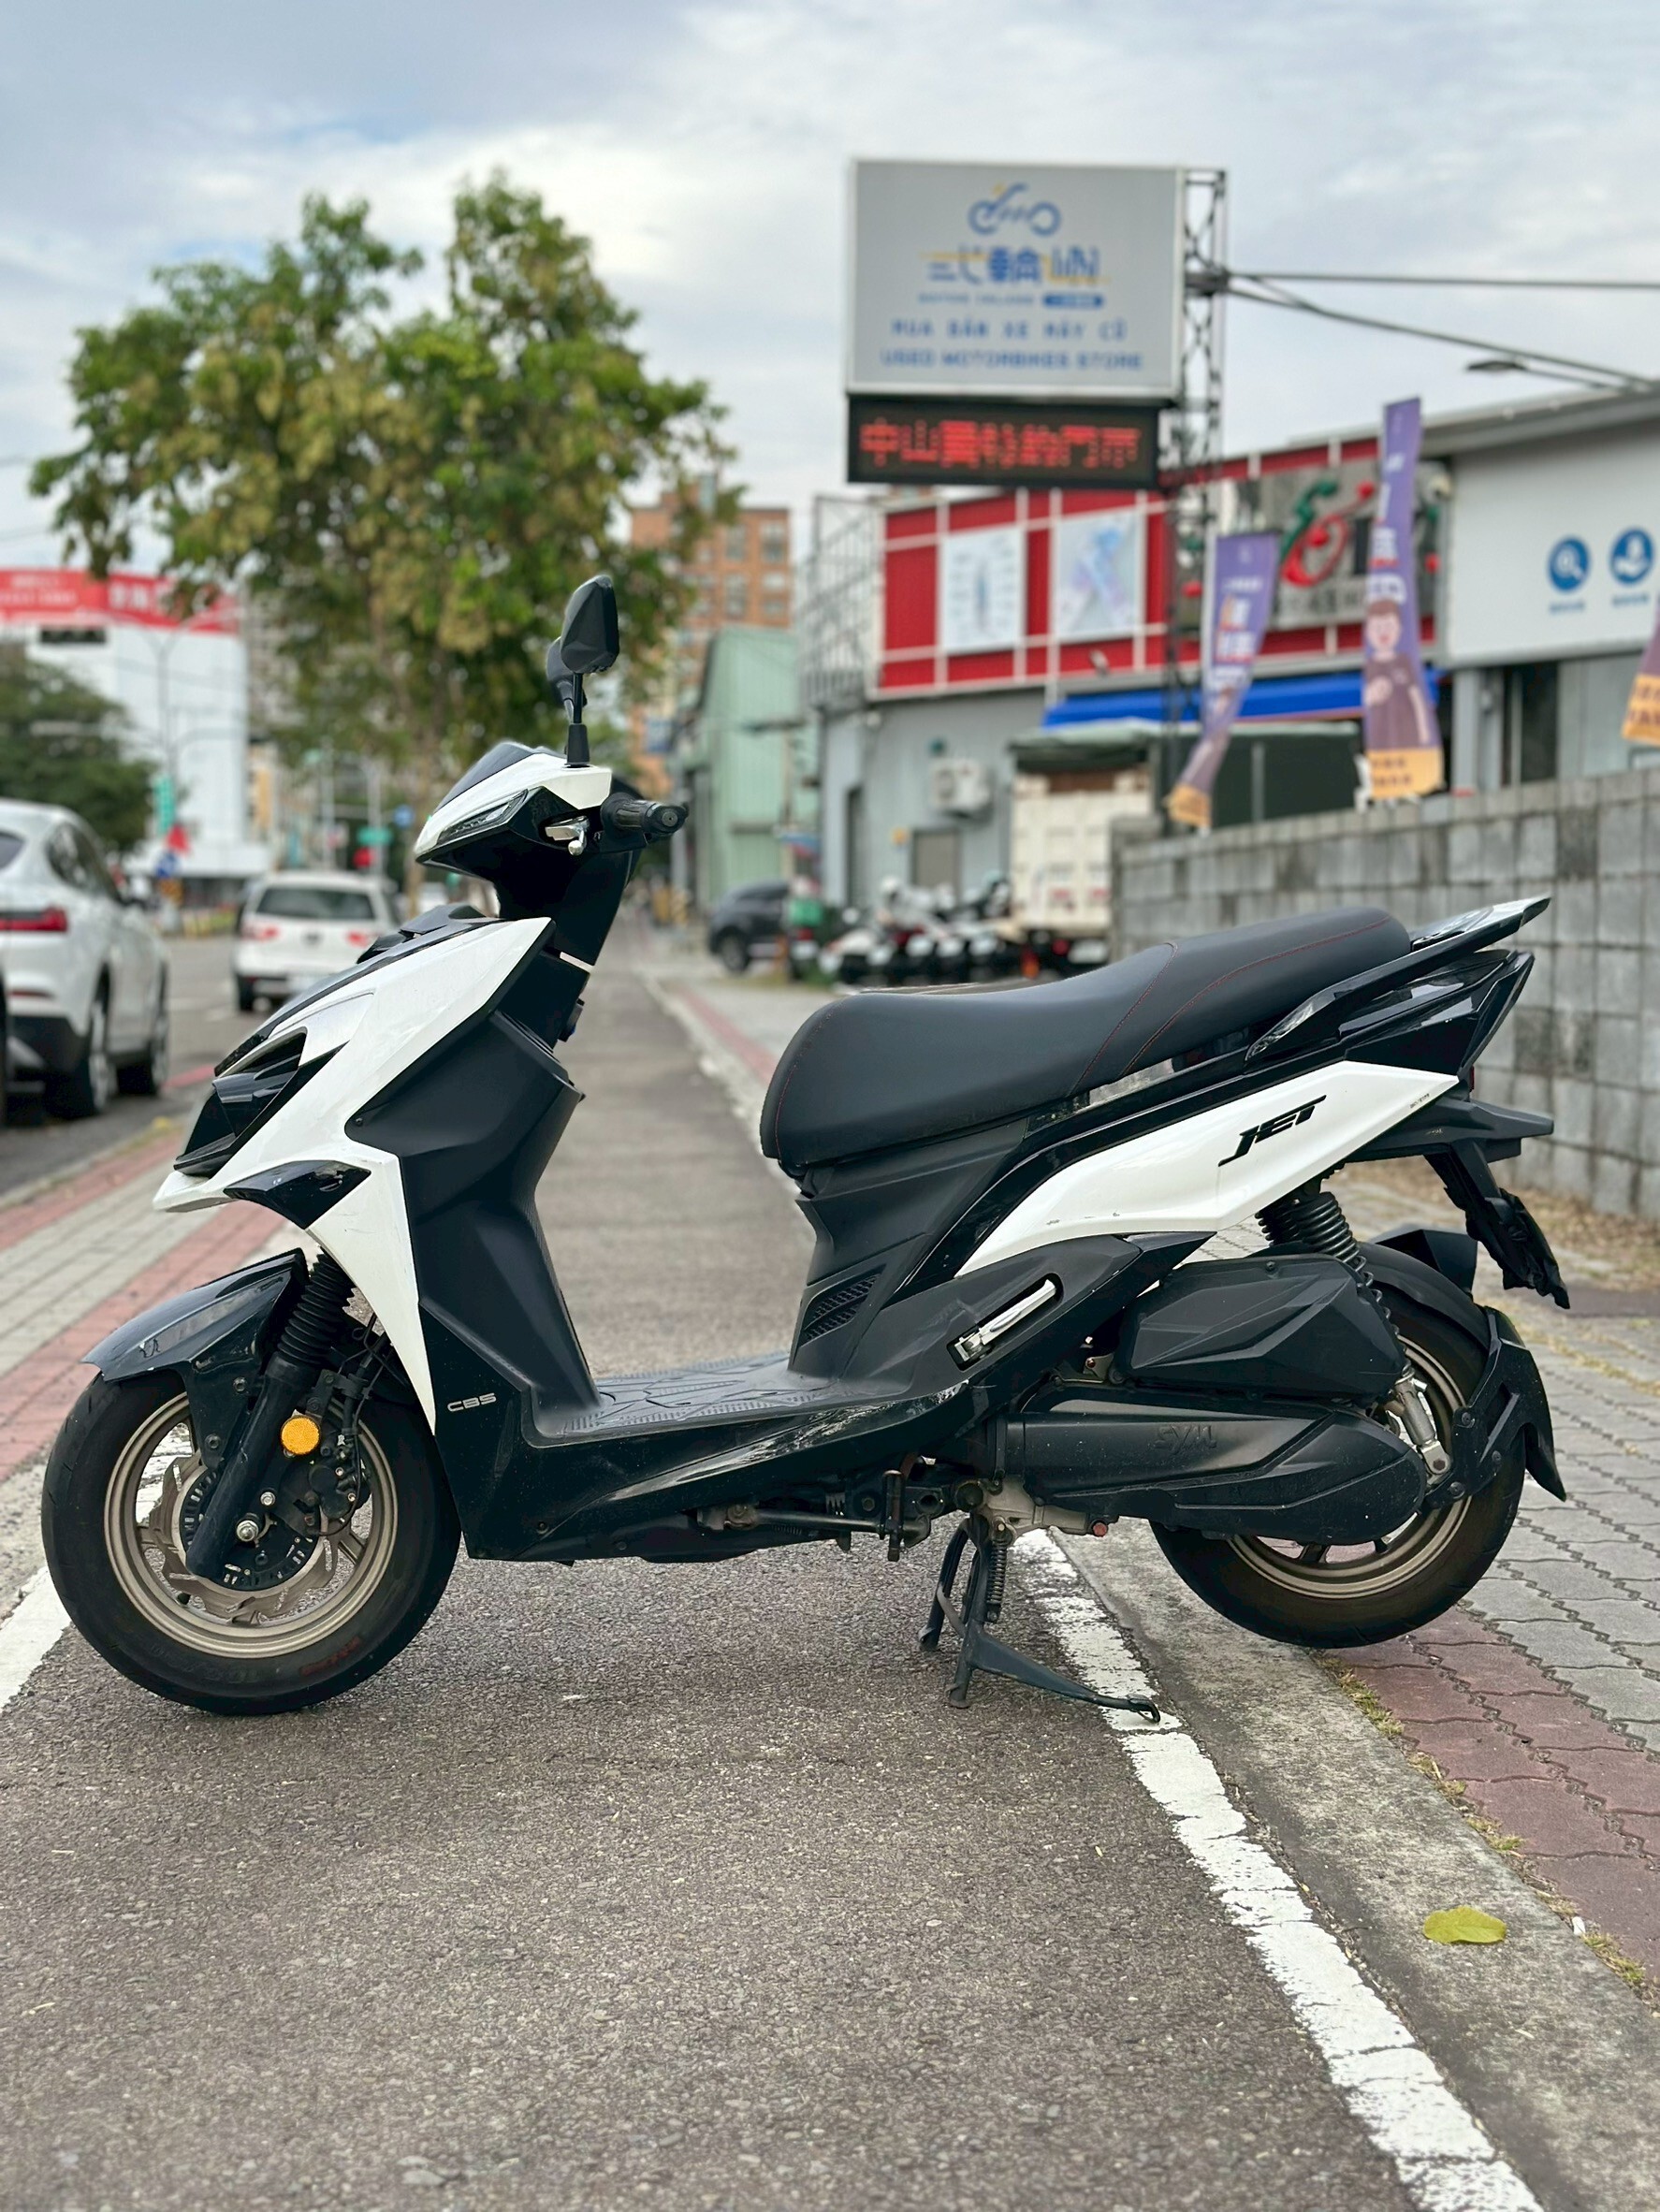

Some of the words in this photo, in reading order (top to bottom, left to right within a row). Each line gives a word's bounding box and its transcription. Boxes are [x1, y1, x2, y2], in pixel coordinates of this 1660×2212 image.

[881, 349, 932, 368] USED
[1077, 352, 1142, 371] STORE
[1218, 1095, 1327, 1167] JET
[447, 1392, 496, 1412] CBS
